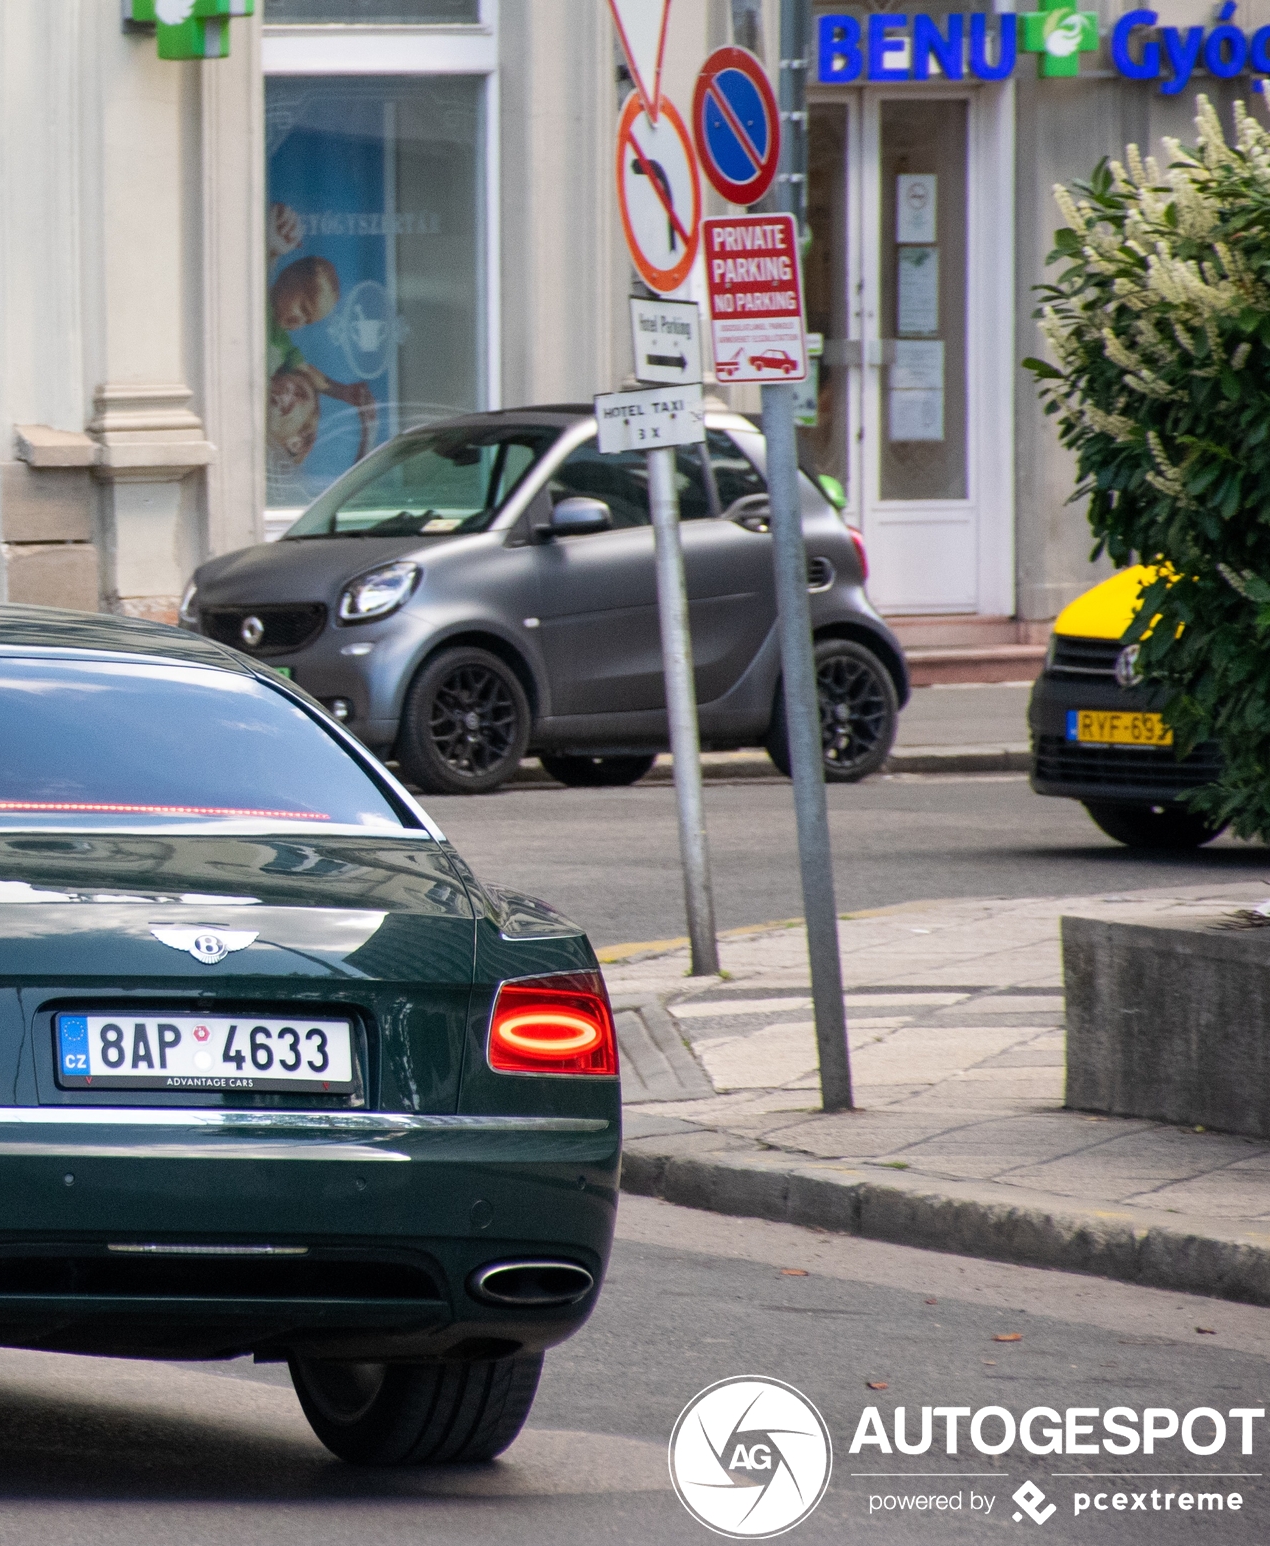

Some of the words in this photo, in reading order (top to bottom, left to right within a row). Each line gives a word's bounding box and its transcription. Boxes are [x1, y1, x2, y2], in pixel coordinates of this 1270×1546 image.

[818, 13, 1017, 83] BENU
[712, 224, 787, 251] PRIVATE
[712, 256, 792, 283] PARKING
[714, 294, 734, 312] NO
[736, 291, 797, 312] PARKING
[638, 313, 658, 333] Hotel
[660, 315, 692, 340] Parking
[603, 405, 645, 419] HOTEL
[651, 400, 684, 414] TAXI
[638, 428, 646, 440] 3
[651, 427, 661, 438] X
[100, 1023, 183, 1070] 8AP
[222, 1024, 330, 1074] 4633
[65, 1054, 87, 1069] CZ
[166, 1077, 227, 1088] ADVANTAGE
[229, 1078, 254, 1088] CARS
